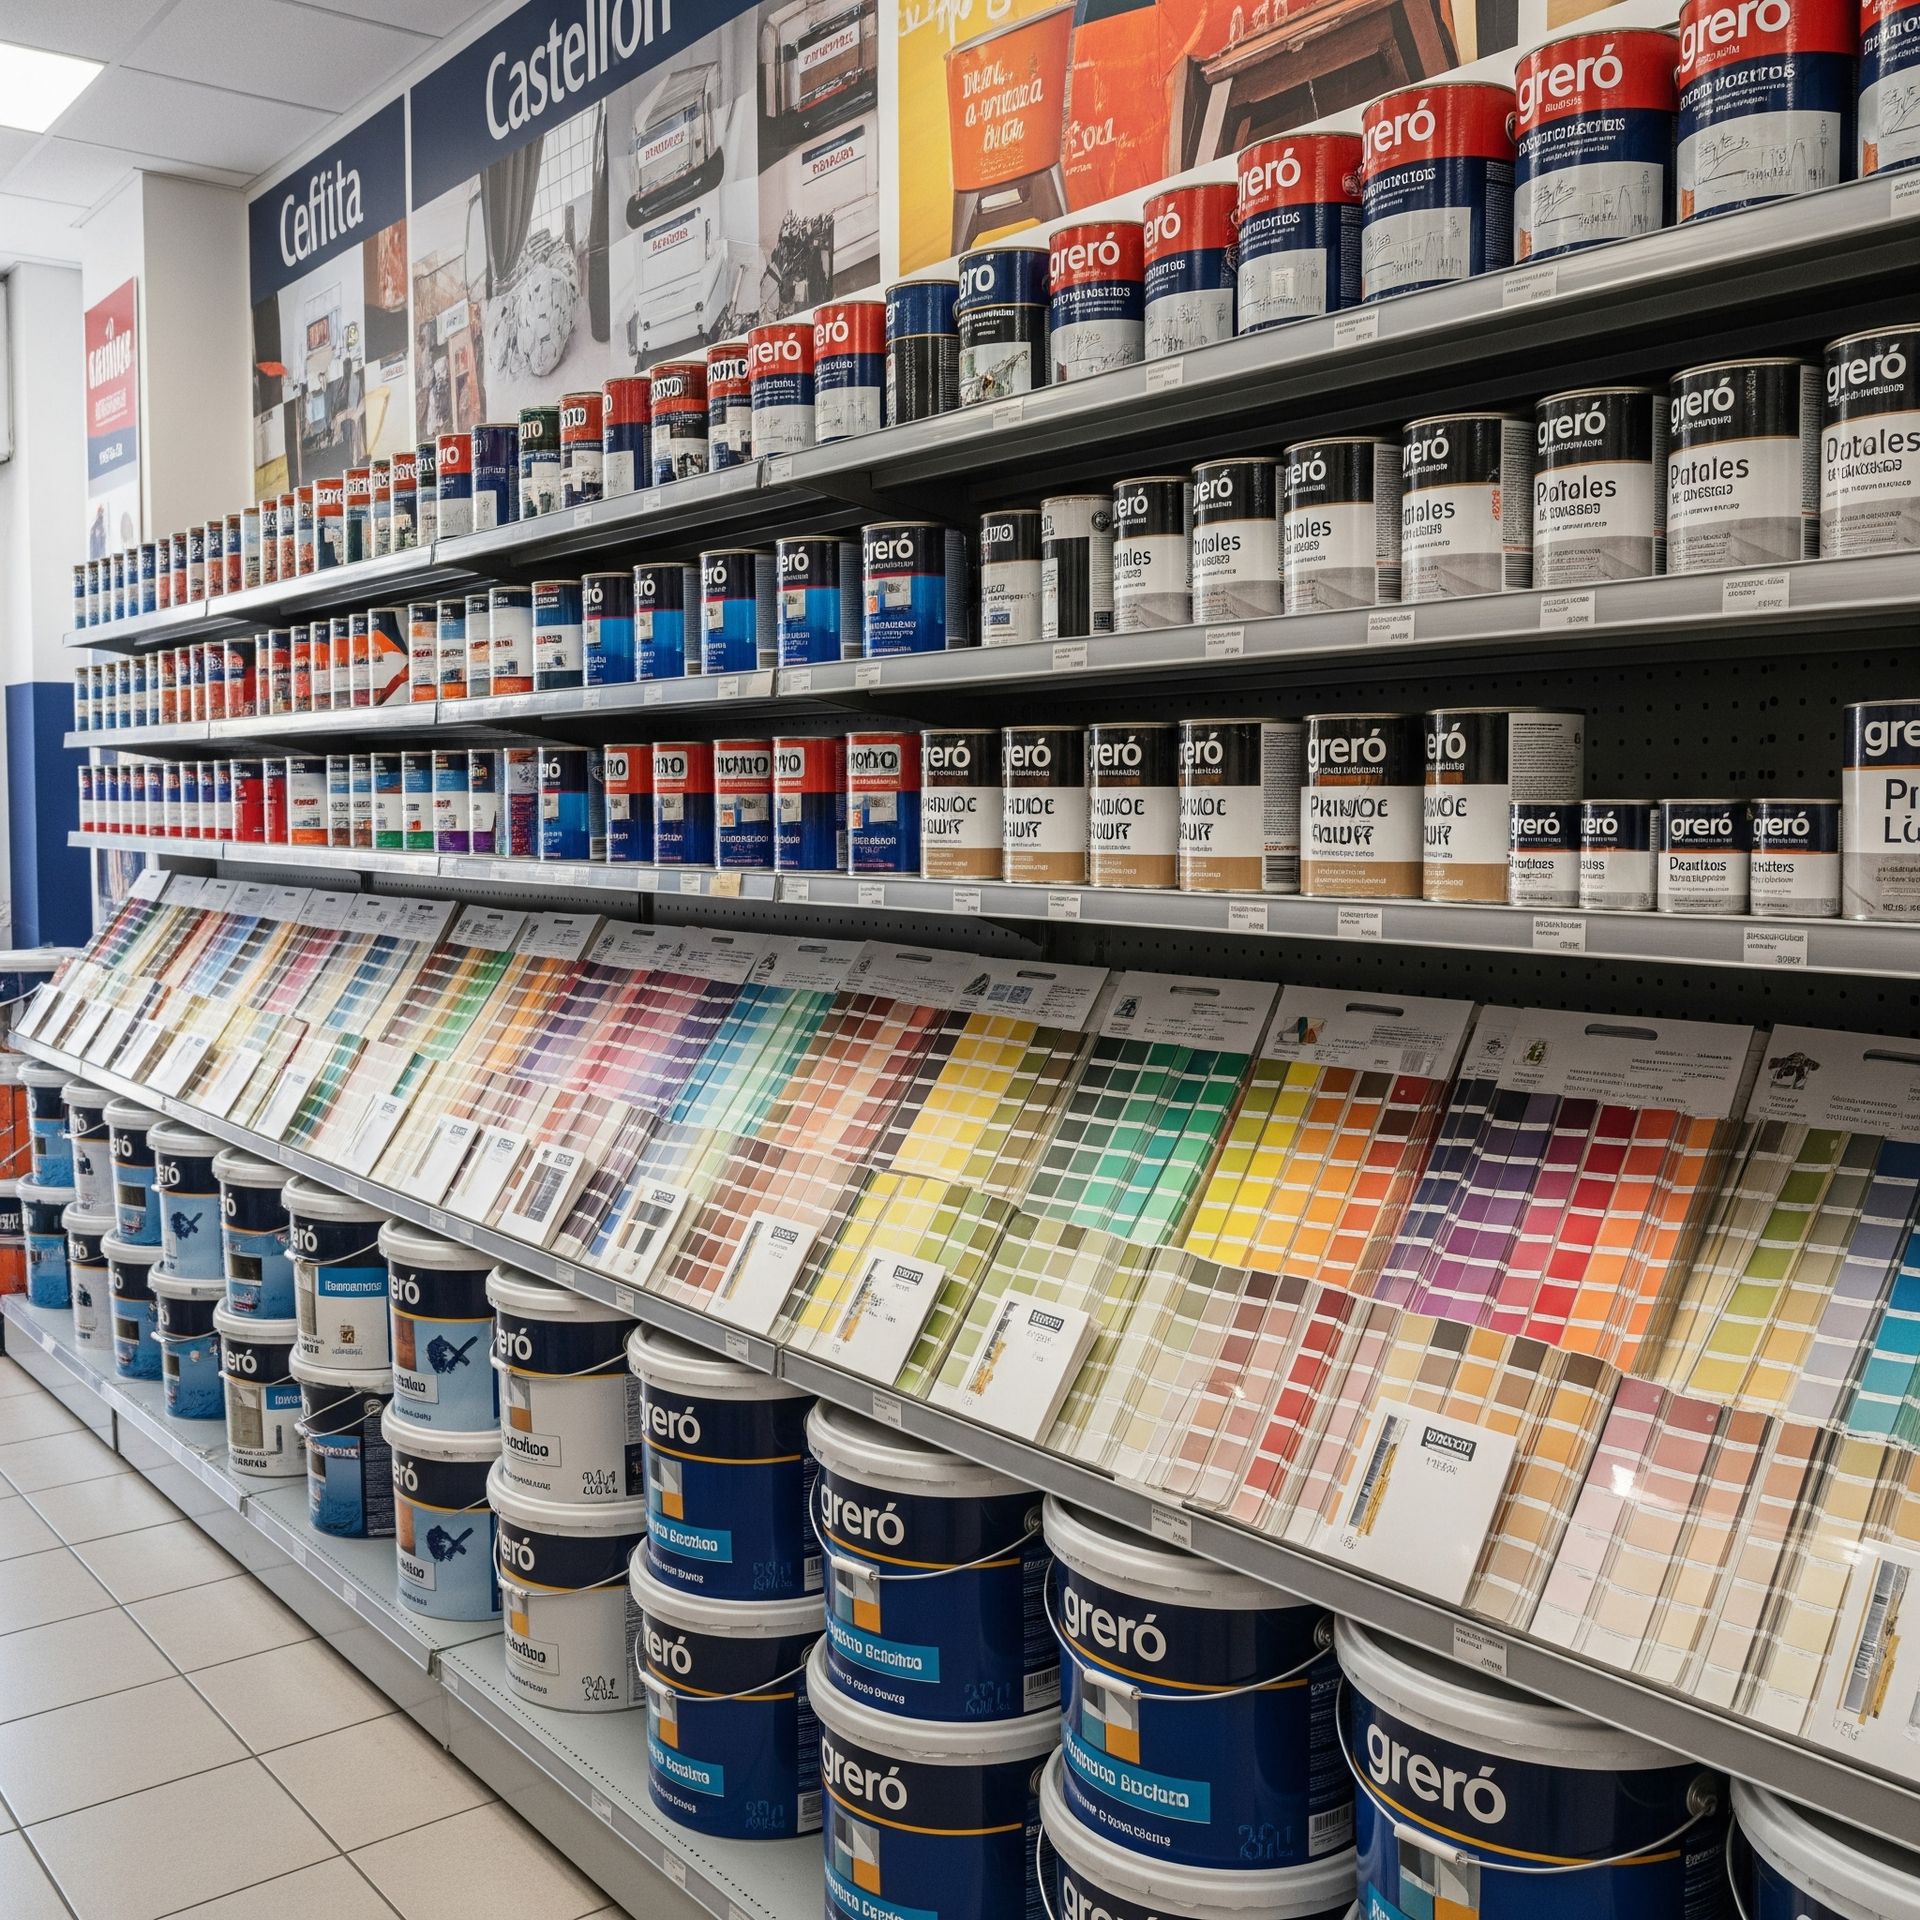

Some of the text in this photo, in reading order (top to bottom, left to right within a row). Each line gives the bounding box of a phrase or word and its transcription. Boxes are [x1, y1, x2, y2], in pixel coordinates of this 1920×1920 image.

[1519, 43, 1623, 125] greró
[1051, 232, 1120, 285] greró
[1827, 343, 1907, 401] greró
[1537, 402, 1606, 453] greró
[1670, 377, 1735, 432] greró
[1307, 728, 1387, 773] greró
[1671, 811, 1733, 841] greró
[1753, 811, 1810, 842] greró
[820, 1483, 905, 1546] greró
[1063, 1585, 1168, 1663] greró
[821, 1735, 908, 1811] greró
[1367, 1722, 1508, 1825] greró
